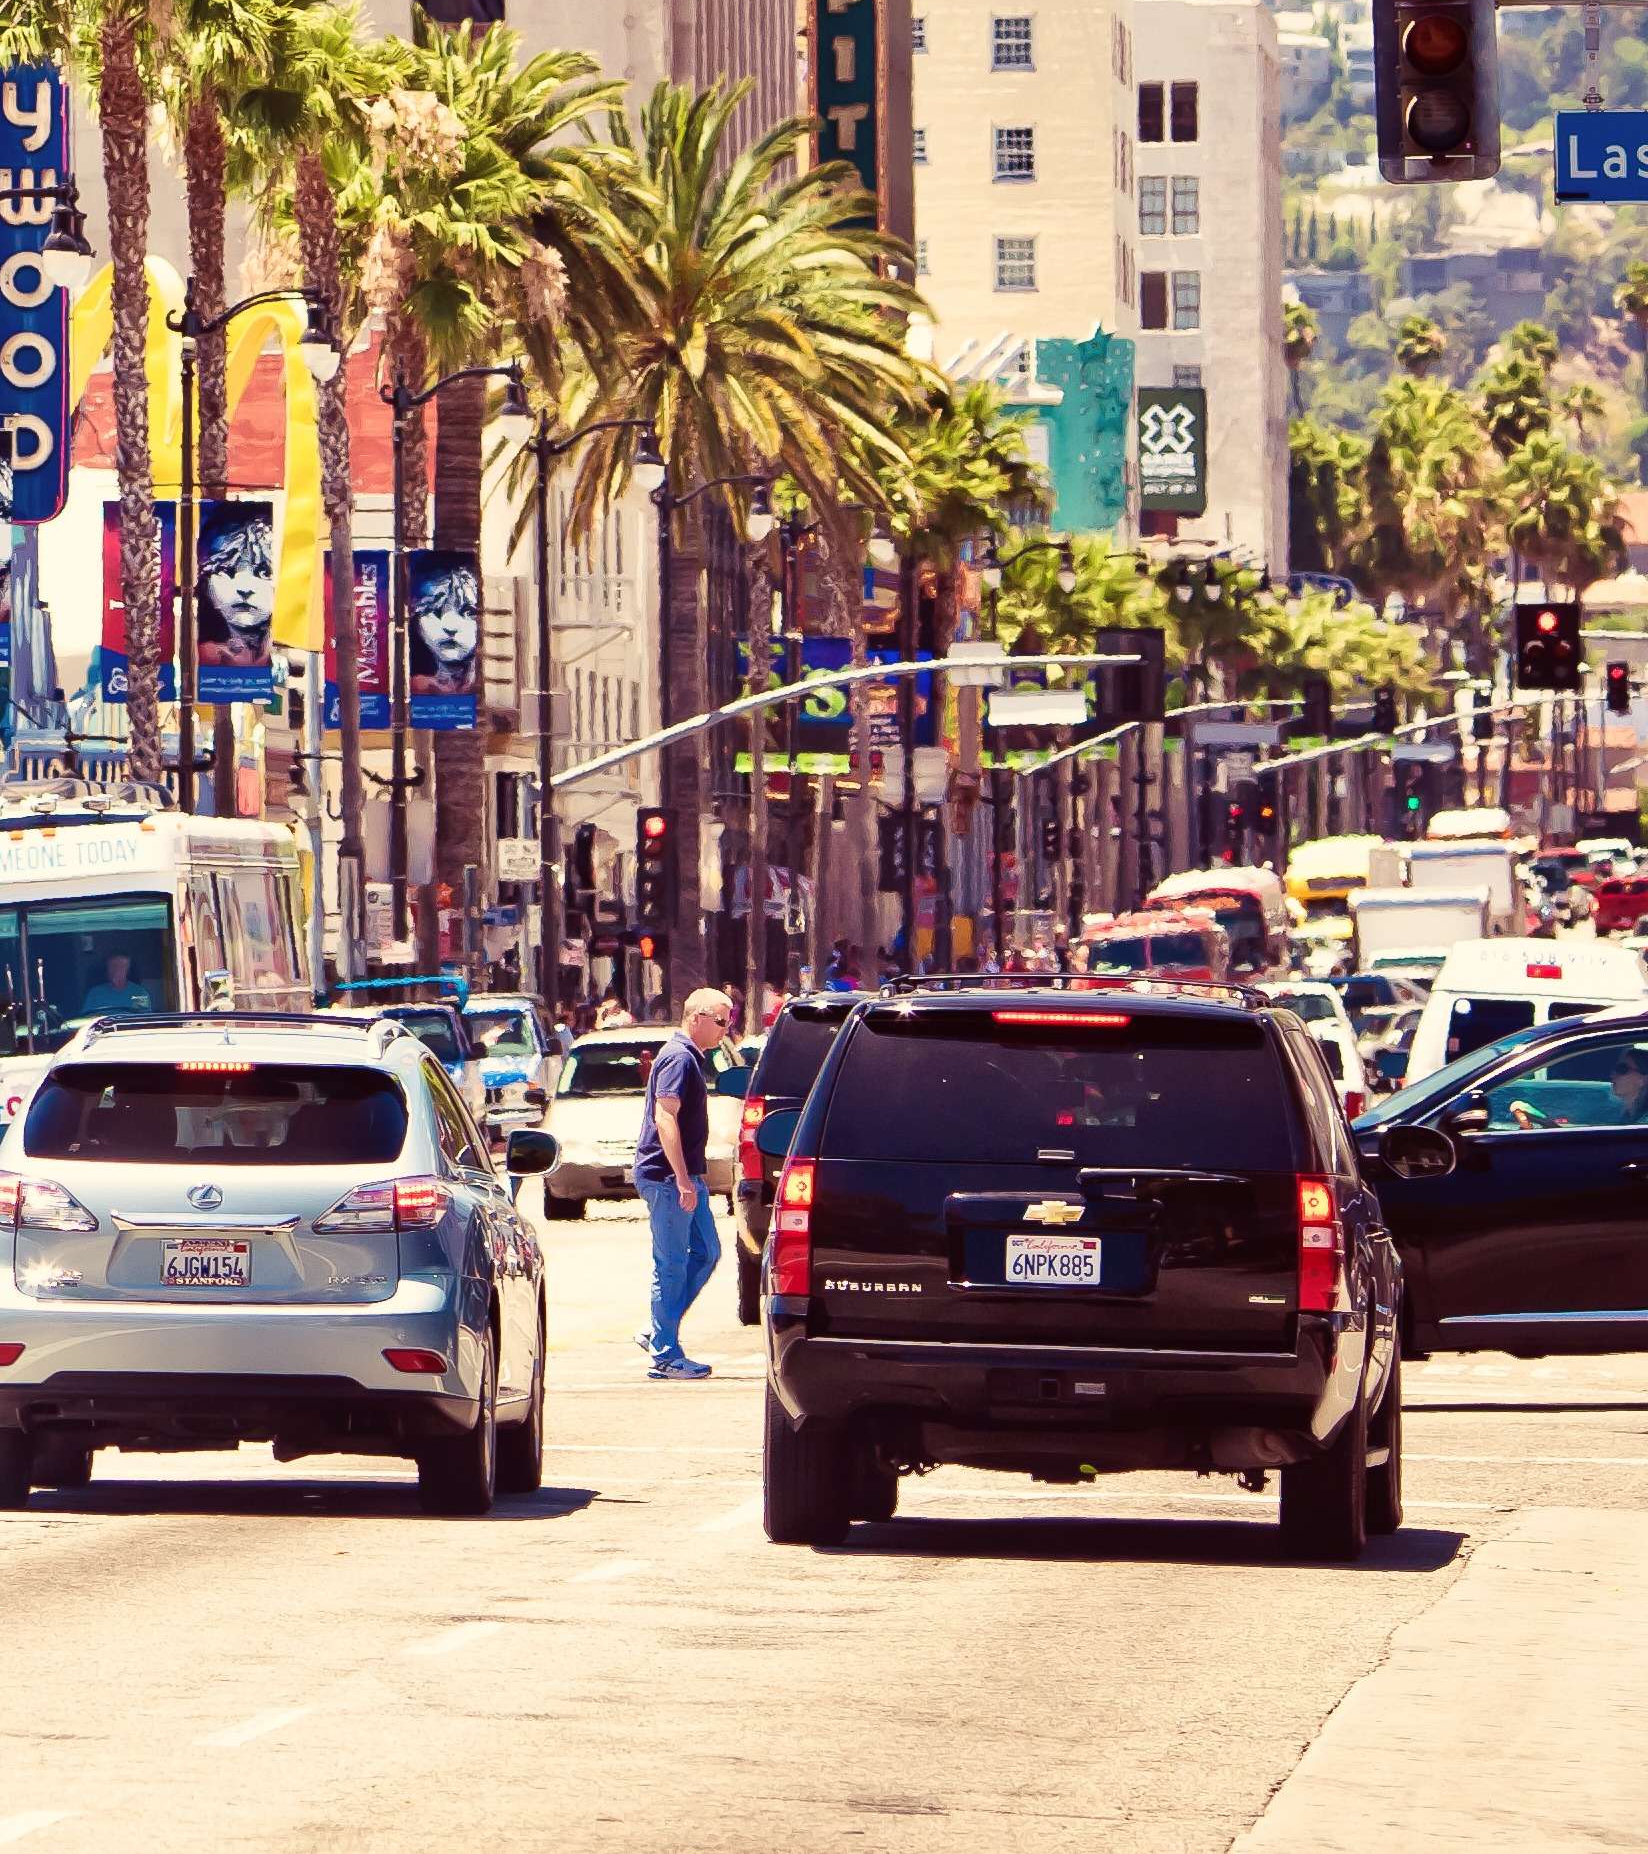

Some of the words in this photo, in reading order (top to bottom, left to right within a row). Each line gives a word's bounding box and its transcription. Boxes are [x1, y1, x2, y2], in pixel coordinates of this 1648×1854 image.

[76, 837, 139, 865] TODAY
[1025, 1238, 1083, 1253] California
[1012, 1253, 1094, 1278] 6NPK885
[824, 1280, 922, 1293] SUBURBAN
